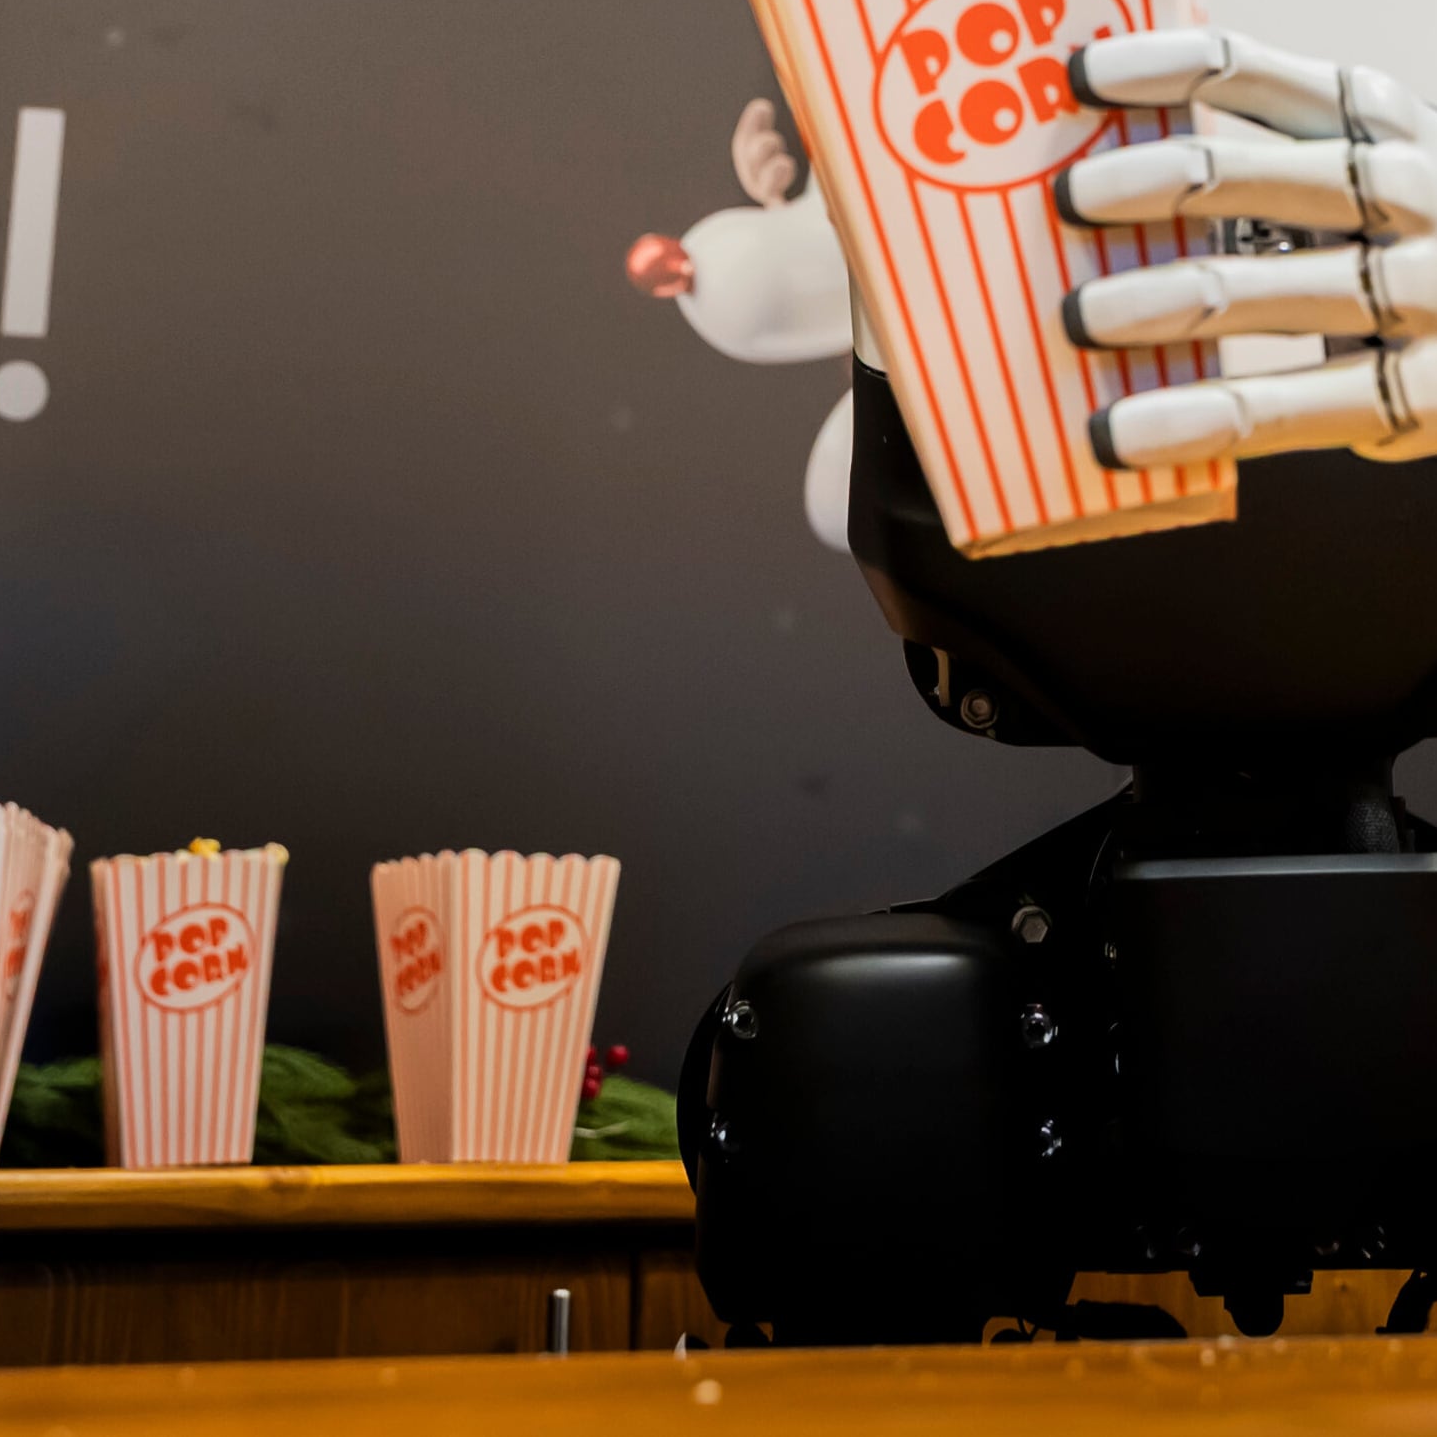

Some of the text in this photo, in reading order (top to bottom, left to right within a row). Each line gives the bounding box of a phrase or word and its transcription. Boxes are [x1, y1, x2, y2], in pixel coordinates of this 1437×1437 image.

[912, 25, 1112, 165] COR
[151, 917, 229, 963] POP
[493, 919, 567, 959] POP
[149, 943, 249, 996] CORN
[490, 947, 581, 993] CORN
